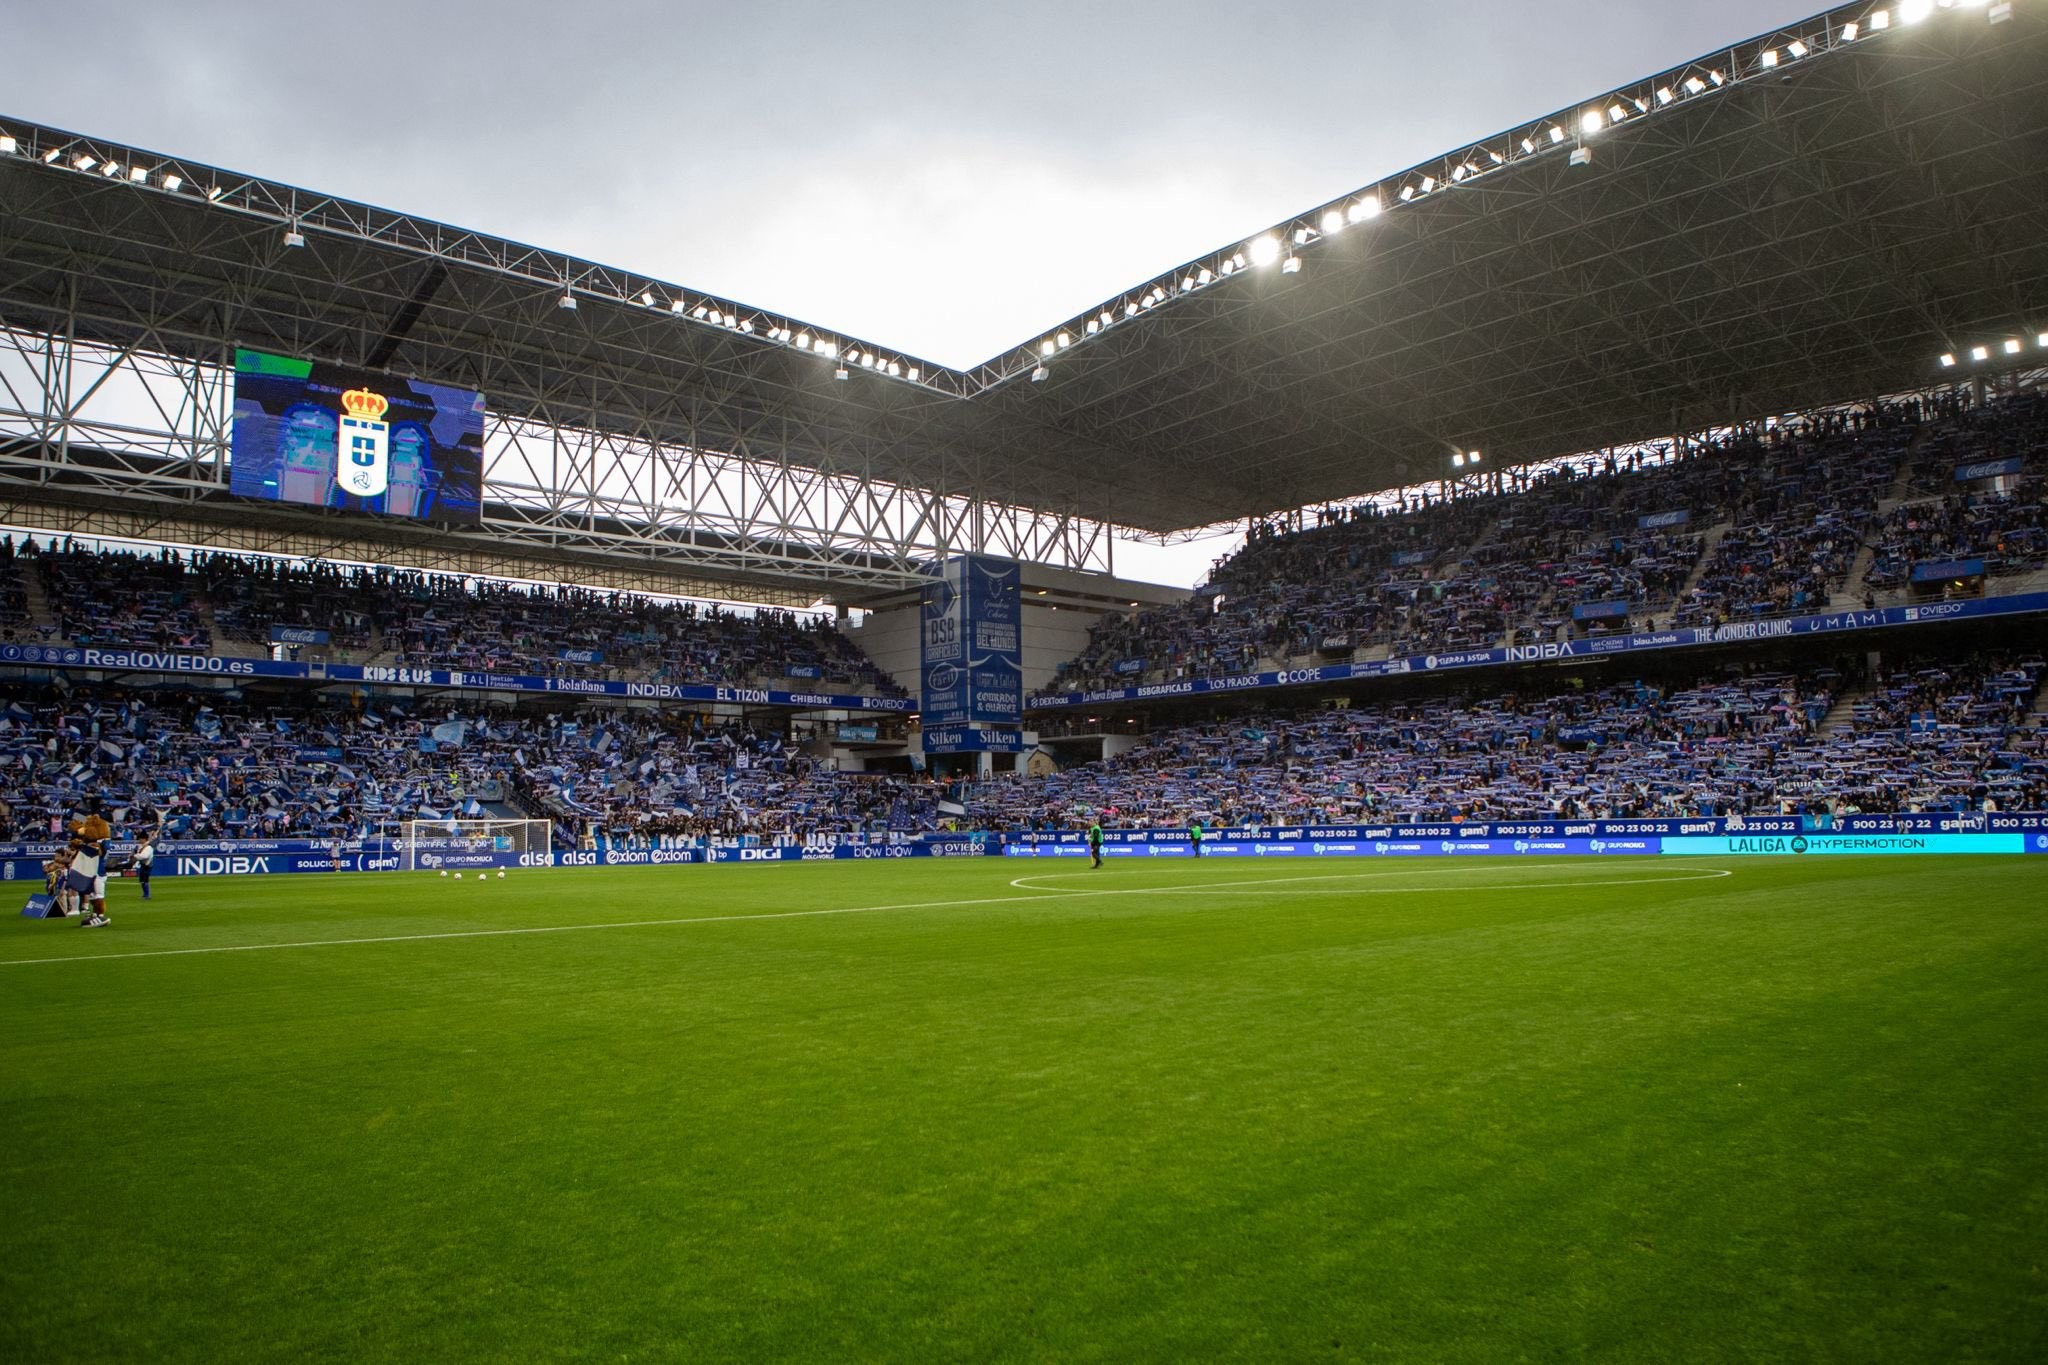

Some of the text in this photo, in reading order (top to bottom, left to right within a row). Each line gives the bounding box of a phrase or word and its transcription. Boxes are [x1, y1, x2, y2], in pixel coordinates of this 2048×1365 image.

[1920, 602, 1962, 615] OVIEDO
[931, 617, 954, 645] BSB
[1694, 619, 1793, 642] THE WONDER CLINIC
[976, 635, 1017, 649] DEL MUNDO
[1633, 634, 1677, 646] blau.hotels
[1438, 652, 1491, 665] TIERRA ASTUR
[1505, 642, 1574, 661] INDIBA
[84, 648, 255, 674] RealOVIEDO.es
[363, 666, 433, 683] KIDS & US
[1289, 668, 1321, 682] COPE
[1138, 682, 1192, 696] BSBGRAFICA.ES
[1210, 675, 1260, 690] LOS PRADOS
[627, 683, 683, 698] INDIBA
[716, 687, 769, 702] EL TIZON
[1082, 688, 1125, 702] La Nueva España
[871, 698, 905, 709] OVIEDO
[929, 731, 962, 746] Silken
[979, 730, 1017, 744] Silken
[1496, 825, 1554, 834] 900 23 00 22
[1605, 823, 1669, 833] 900 23 00 22
[1724, 821, 1795, 832] 900 23 00 22
[1852, 820, 1877, 829] 900
[1879, 820, 1894, 829] 23
[1916, 819, 1931, 829] 22
[1992, 818, 2019, 828] 900
[2022, 817, 2038, 827] 23
[1309, 830, 1357, 838] 900 23 00 22
[1398, 828, 1451, 836] 900 23 00 22
[310, 840, 319, 849] La
[944, 843, 985, 852] OVIEDO
[1728, 838, 1786, 852] LALIGA
[1810, 838, 1925, 849] HYPERMOTION
[465, 855, 493, 863] PACHUCA
[519, 851, 555, 866] alsa
[562, 850, 597, 865] alsa
[718, 851, 728, 859] bp
[740, 848, 782, 860] DIGI
[177, 857, 270, 875] INDIBA
[297, 859, 352, 868] SOLUCIOES
